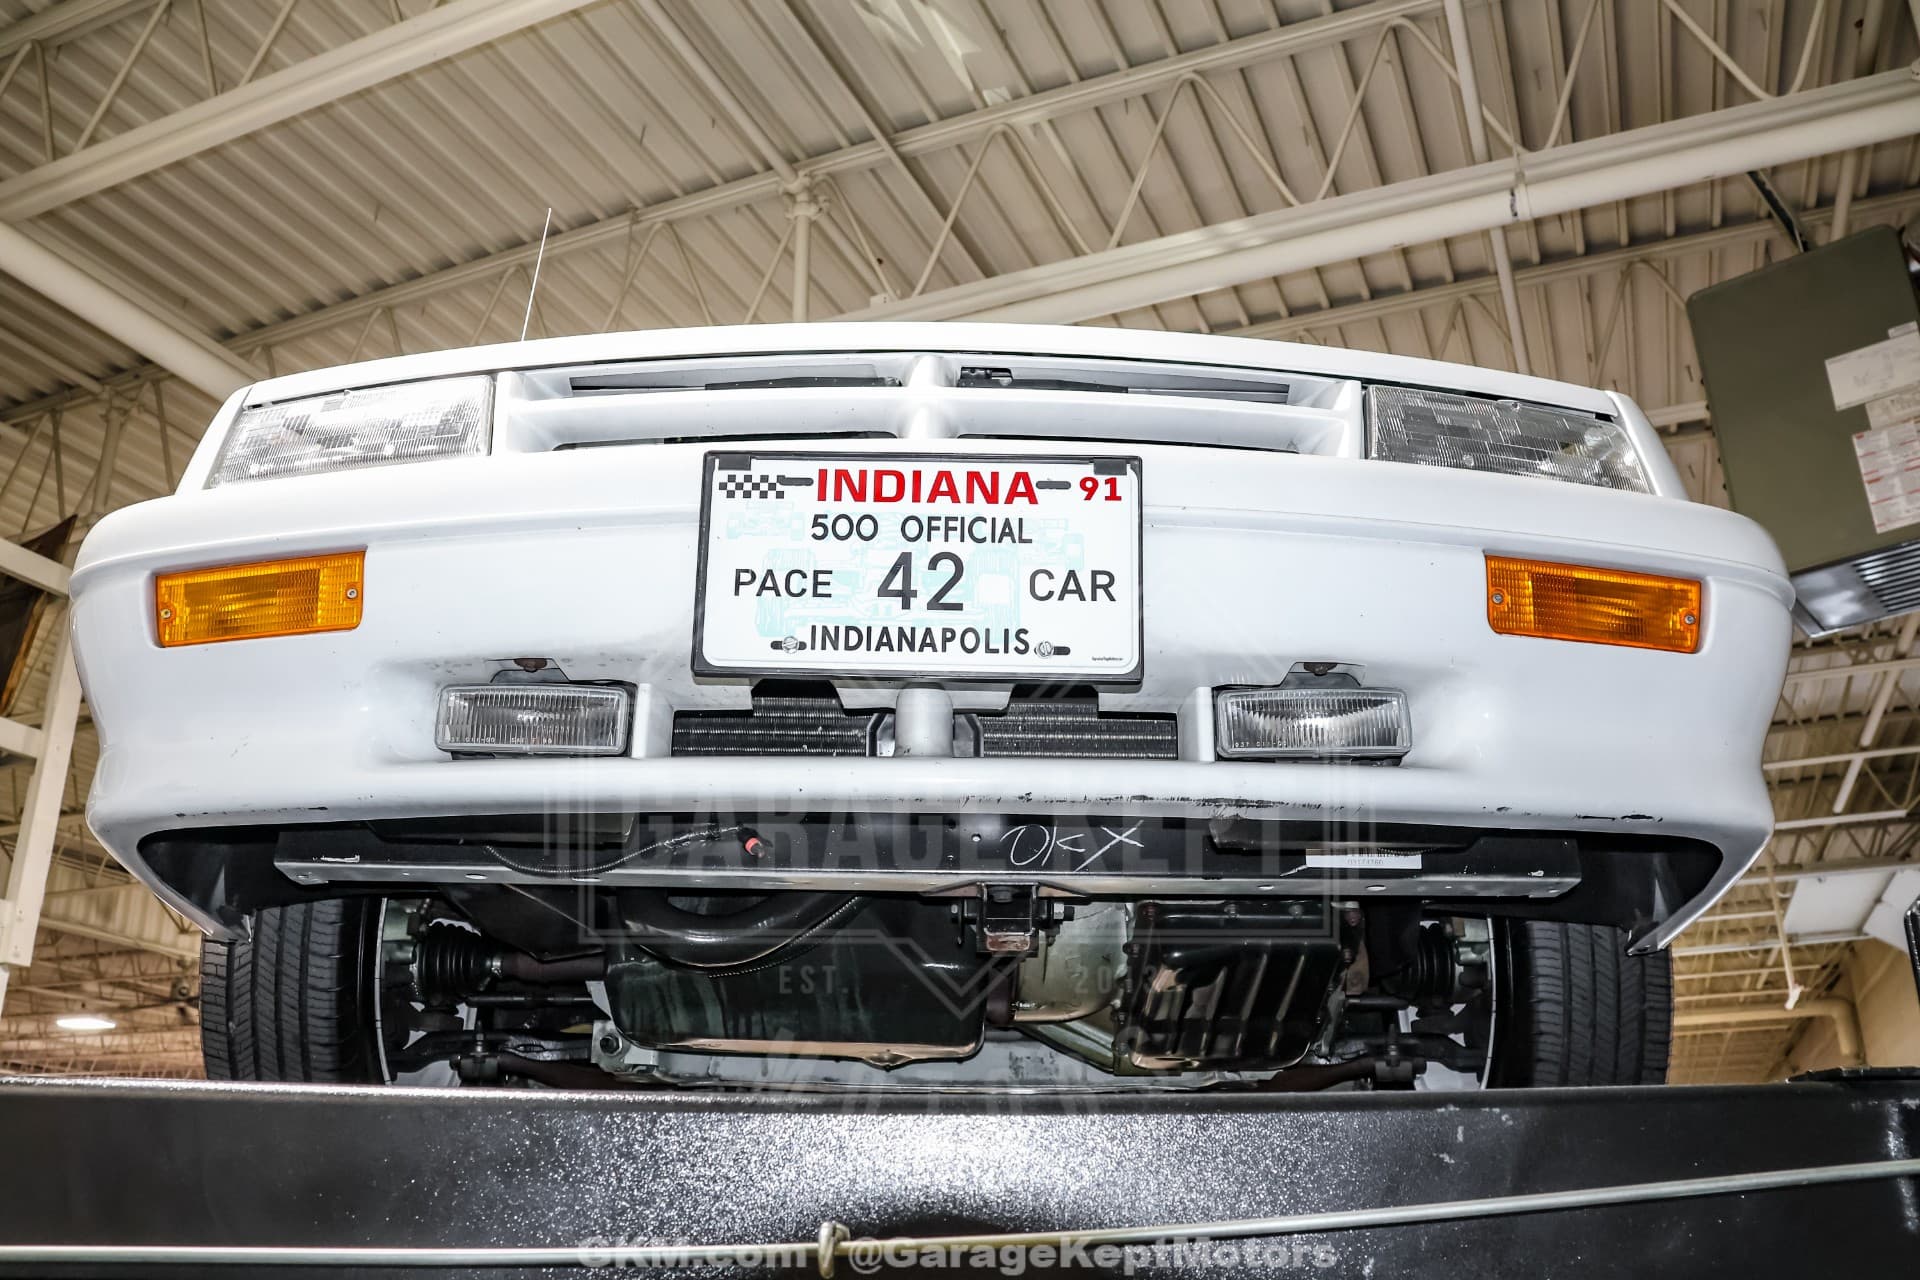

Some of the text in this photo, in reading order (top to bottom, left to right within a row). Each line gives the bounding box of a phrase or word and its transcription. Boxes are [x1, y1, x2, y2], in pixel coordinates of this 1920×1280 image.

[818, 469, 1122, 504] INDIANA 91
[812, 514, 1032, 543] 500 OFFICIAL
[735, 552, 1116, 611] PACE 42 CAR
[811, 625, 1029, 654] INDIANAPOLIS
